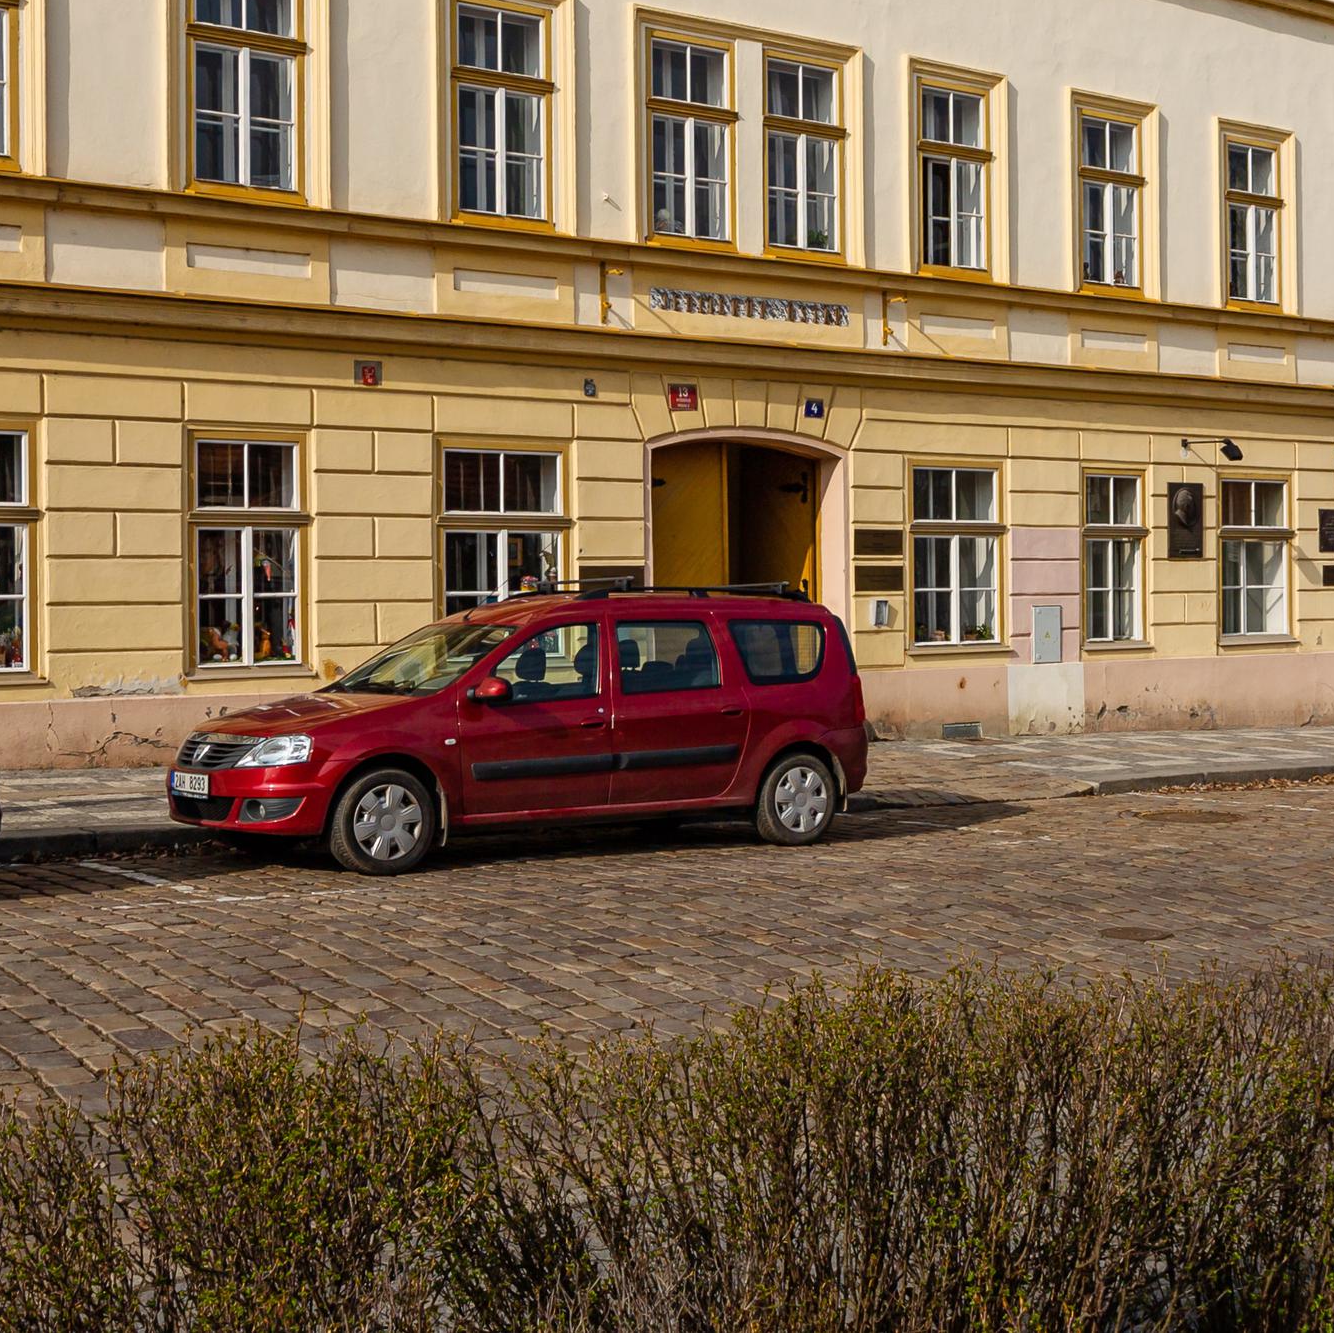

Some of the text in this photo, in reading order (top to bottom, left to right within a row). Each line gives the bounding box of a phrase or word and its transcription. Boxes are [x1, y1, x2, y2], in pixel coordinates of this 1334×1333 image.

[678, 386, 689, 398] 13
[811, 402, 818, 414] 4
[189, 775, 206, 792] 8293
